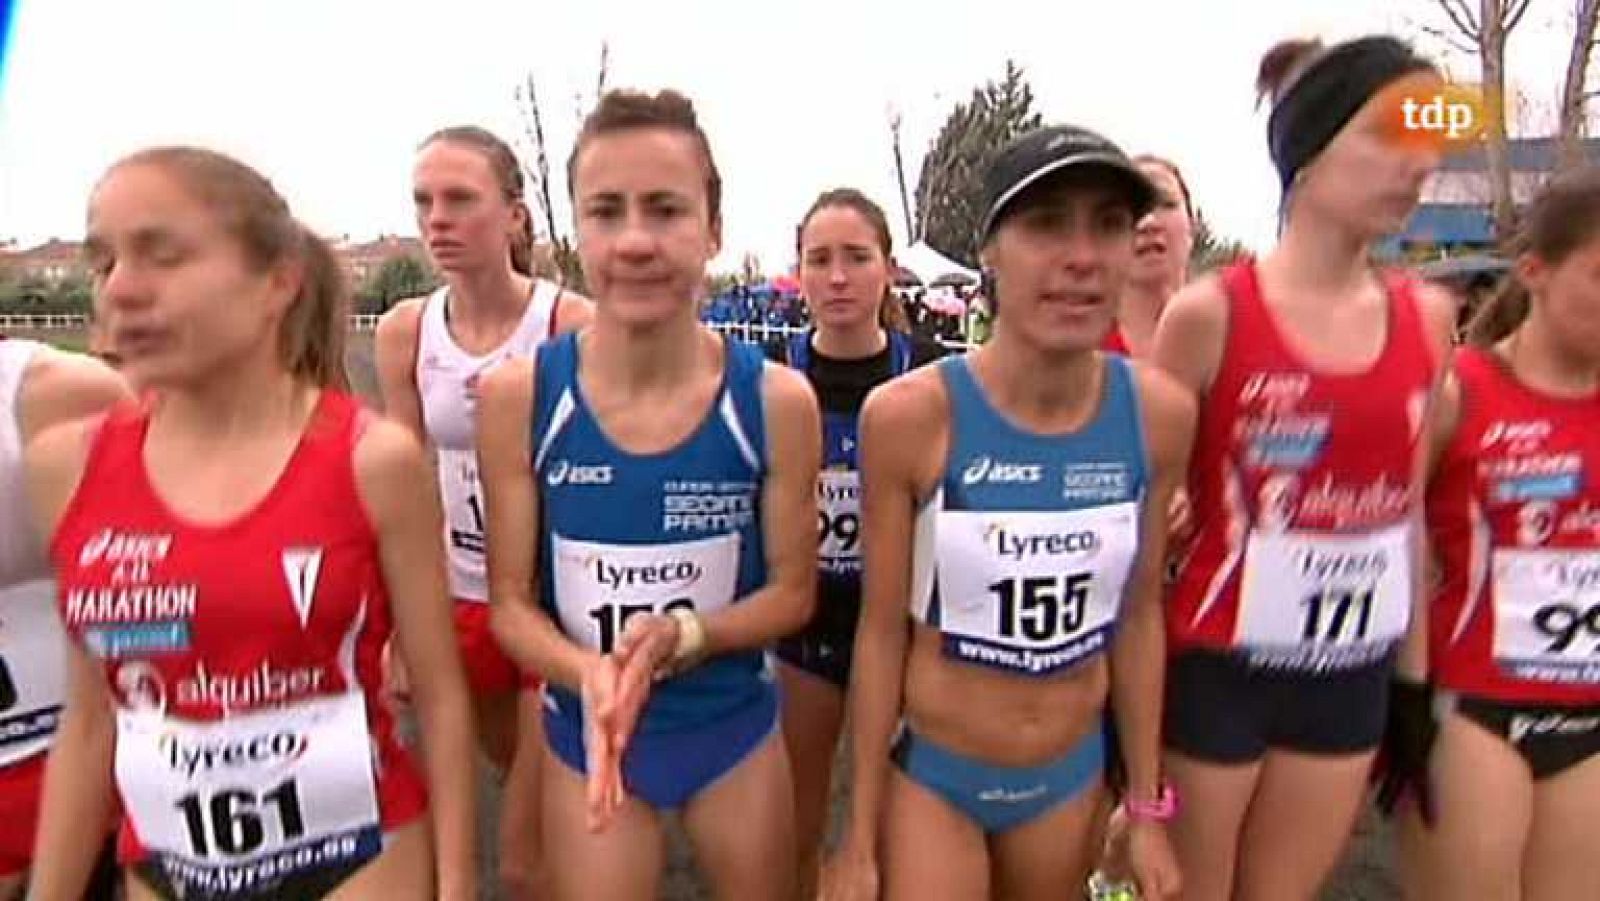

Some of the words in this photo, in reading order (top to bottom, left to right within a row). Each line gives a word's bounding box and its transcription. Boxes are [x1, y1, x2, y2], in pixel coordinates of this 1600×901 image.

[999, 530, 1095, 560] Lyreco
[597, 558, 694, 590] Lyreco
[988, 573, 1093, 641] 155
[1302, 588, 1374, 638] 171
[175, 778, 304, 857] 161
